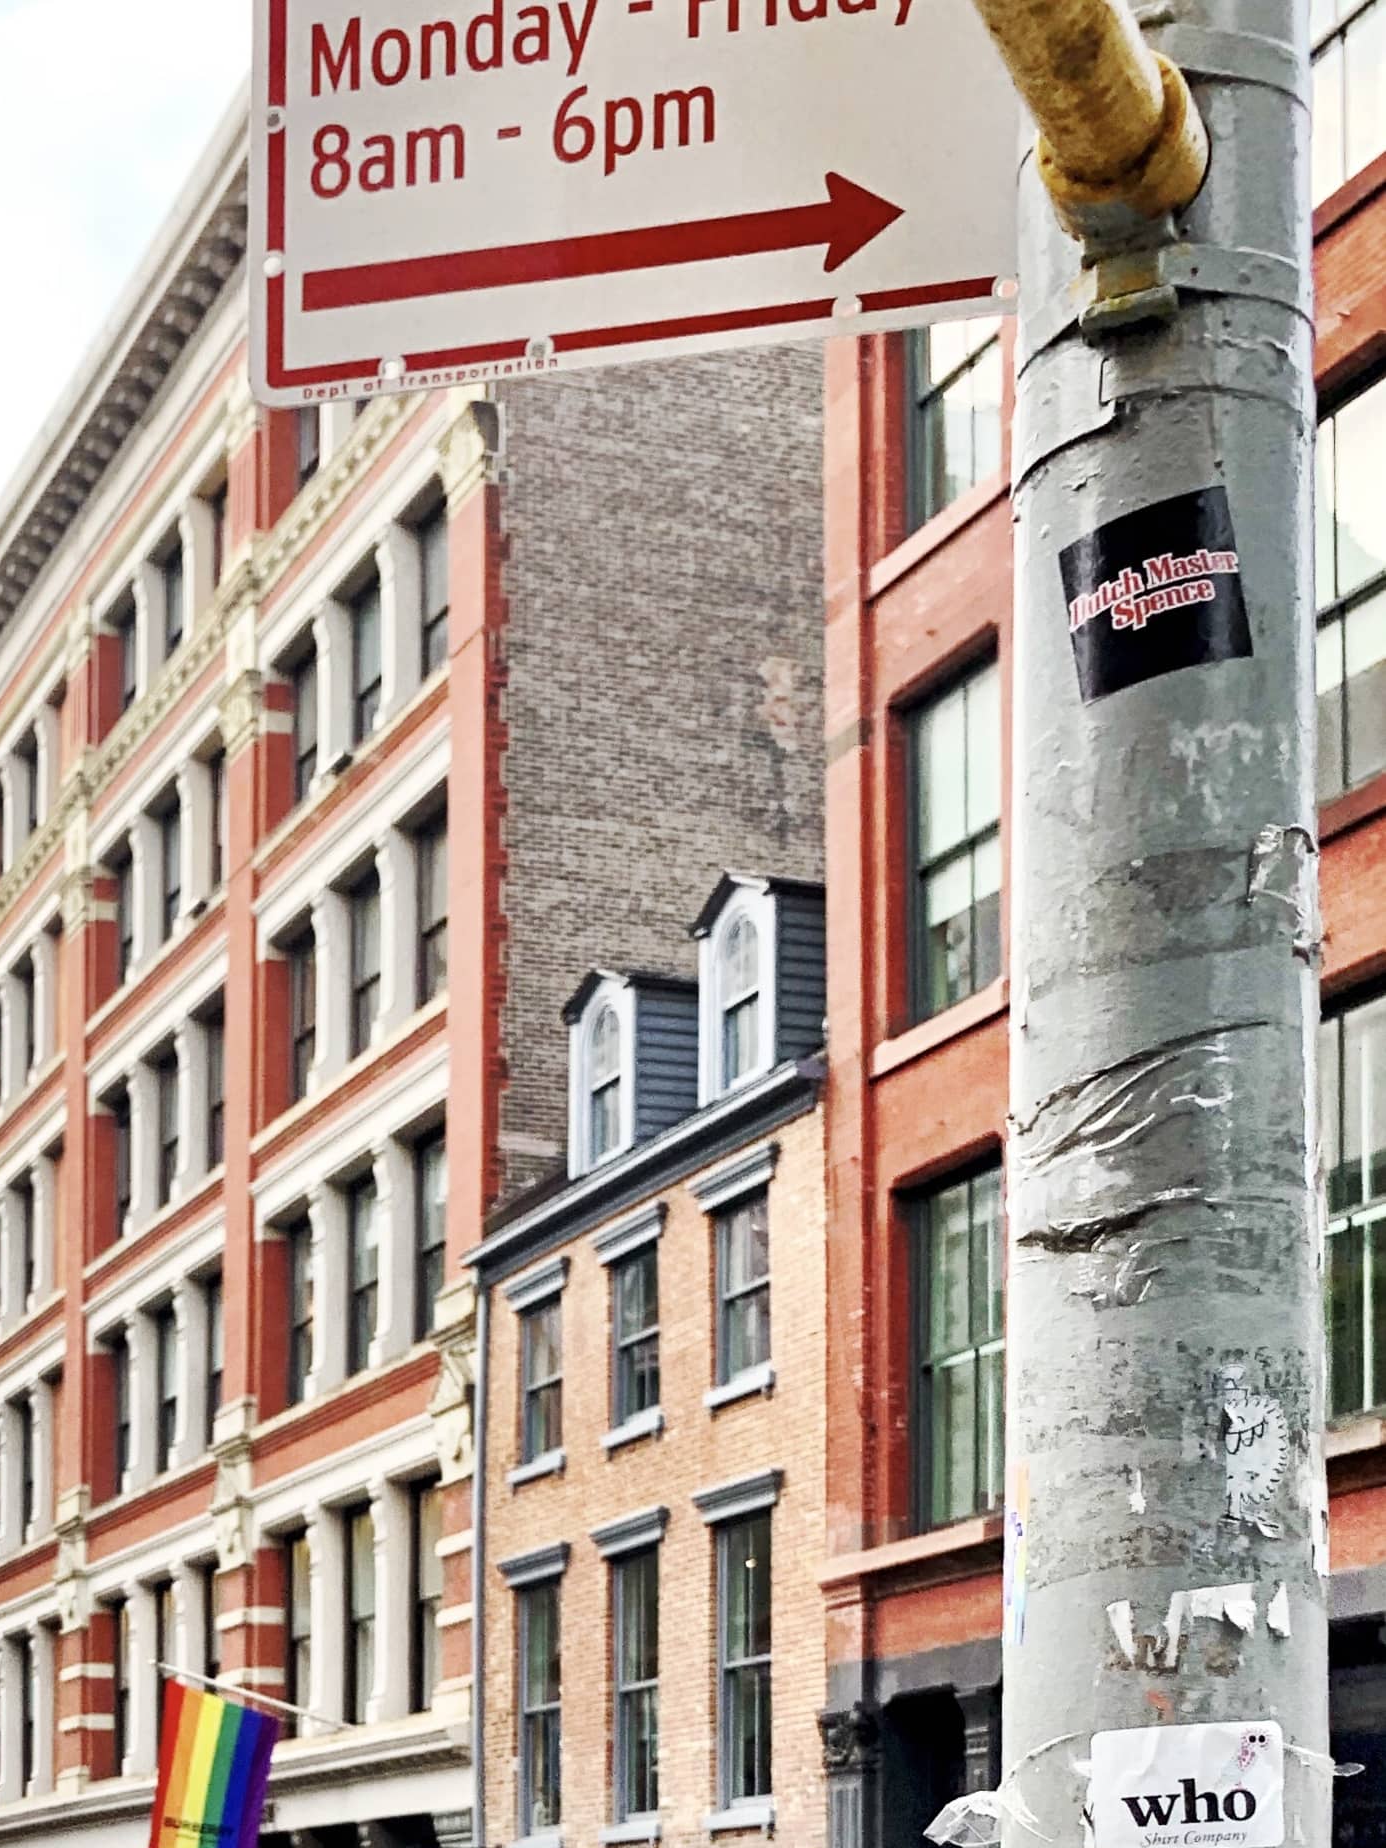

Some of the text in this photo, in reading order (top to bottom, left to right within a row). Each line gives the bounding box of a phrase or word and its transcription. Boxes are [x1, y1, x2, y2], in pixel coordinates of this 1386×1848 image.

[310, 0, 598, 97] Monday
[310, 121, 465, 199] 8am
[552, 83, 717, 177] 6pm
[302, 356, 559, 400] Dept of Transportation
[1070, 549, 1239, 631] Dutch Master
[1112, 580, 1216, 630] Spence
[1121, 1778, 1257, 1828] who
[1140, 1830, 1248, 1848] Shirt Company
